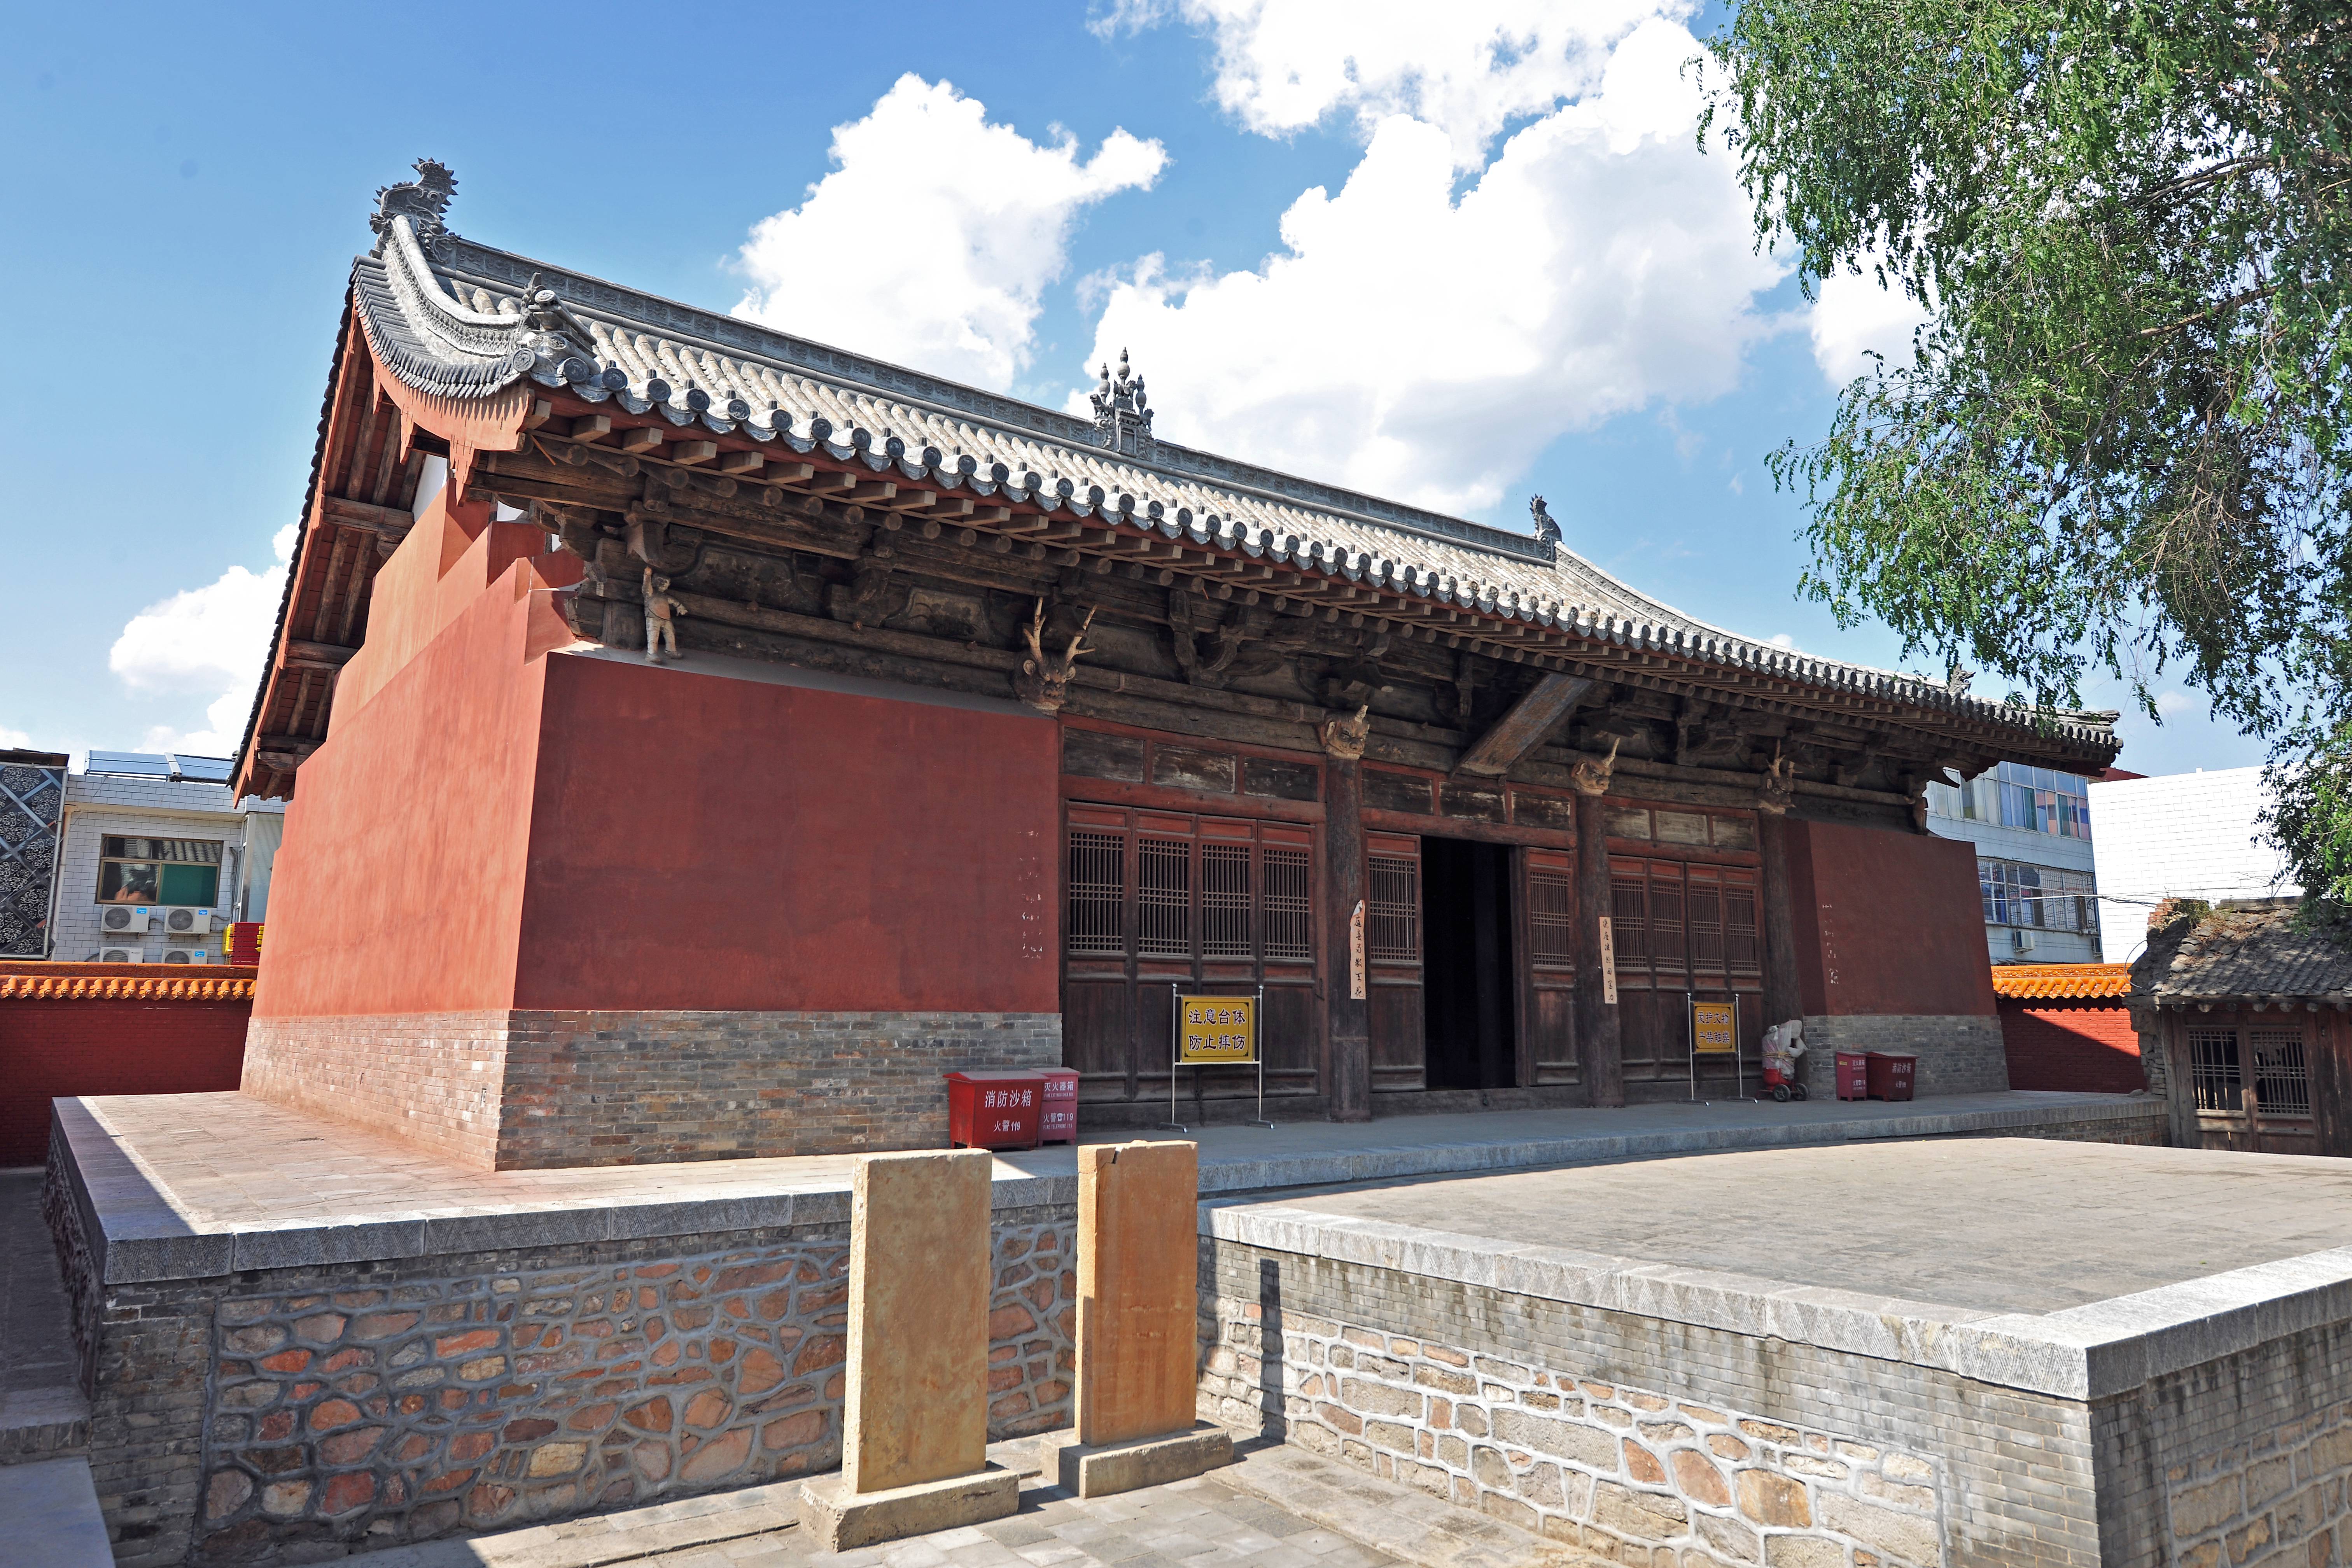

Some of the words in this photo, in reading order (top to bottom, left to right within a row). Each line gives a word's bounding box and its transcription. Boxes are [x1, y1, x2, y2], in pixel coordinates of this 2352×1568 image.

[1188, 1008, 1245, 1025] 注意台体
[1697, 1011, 1729, 1024] 爱护文物
[1188, 1034, 1245, 1050] 防止摔伤
[1698, 1031, 1730, 1044] 严禁触摸
[1045, 1081, 1074, 1092] 灭火器箱
[985, 1089, 1032, 1108] 消防沙箱
